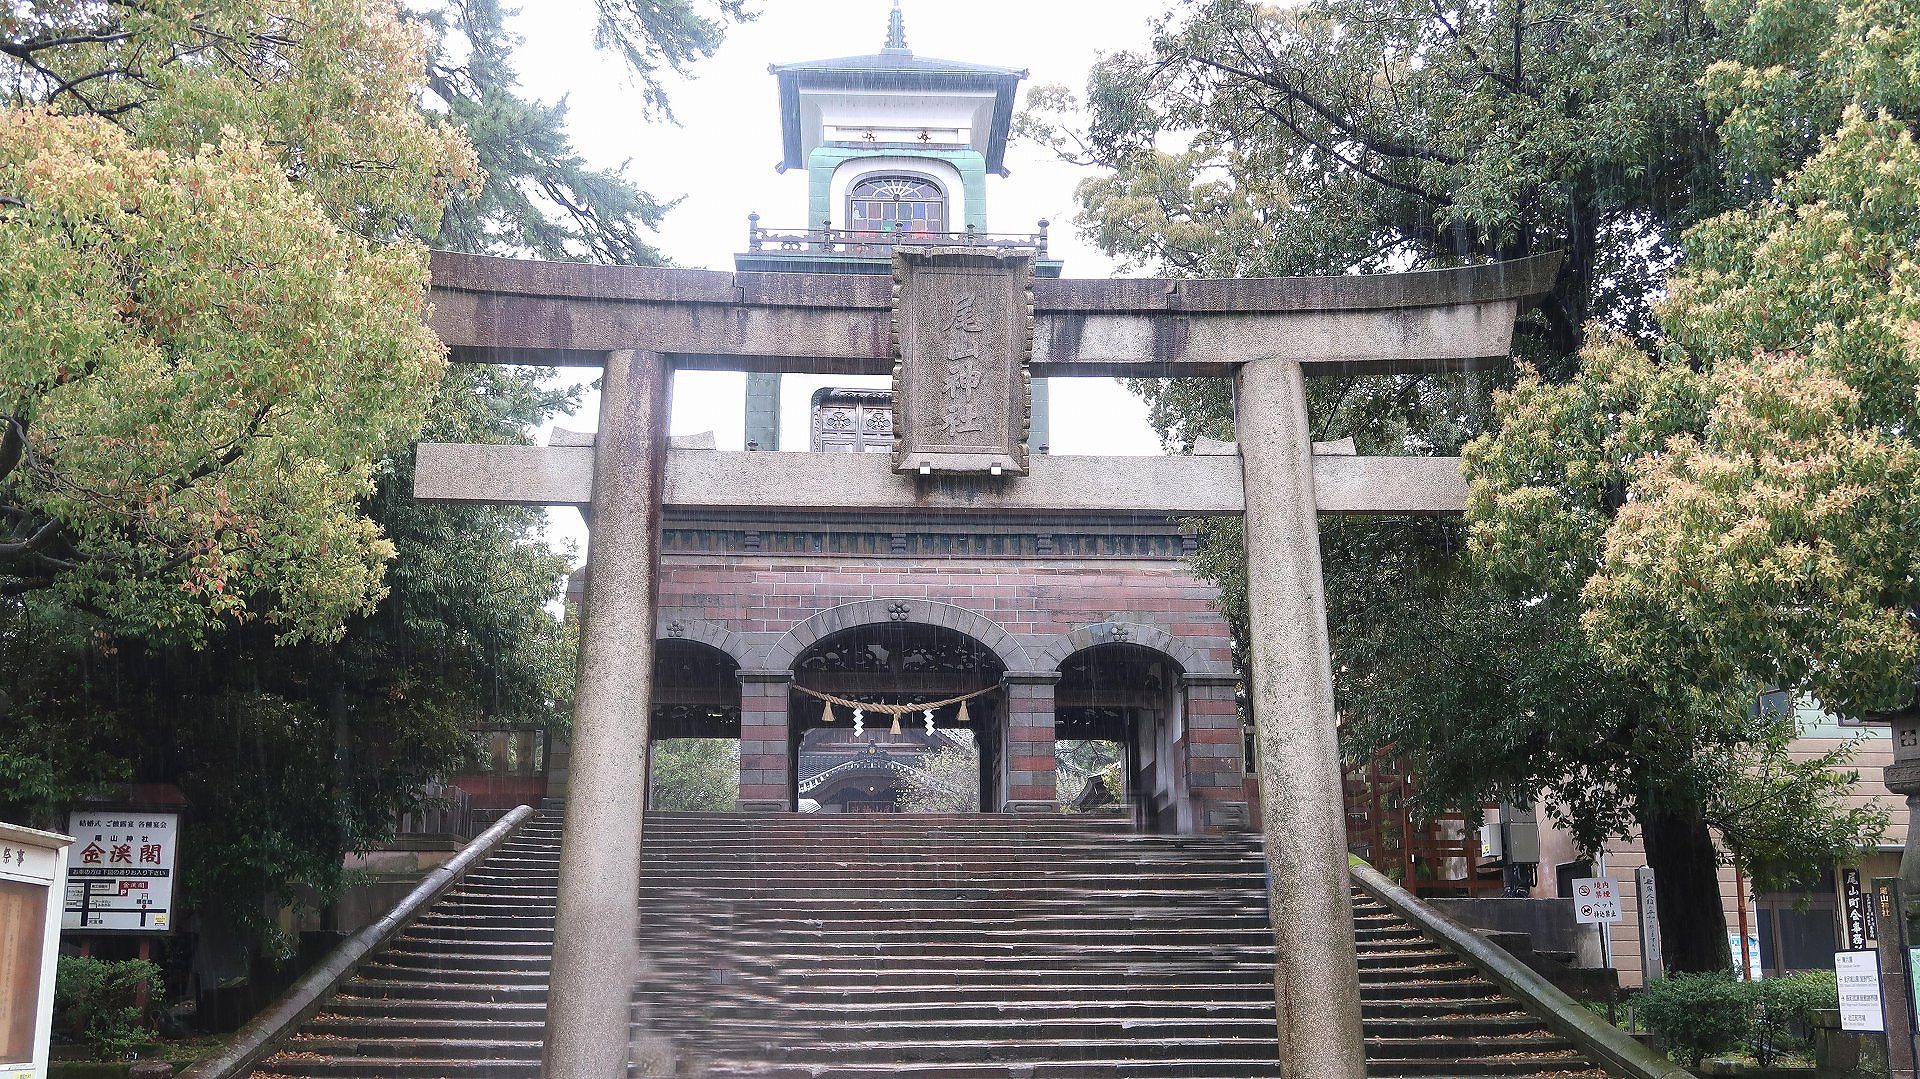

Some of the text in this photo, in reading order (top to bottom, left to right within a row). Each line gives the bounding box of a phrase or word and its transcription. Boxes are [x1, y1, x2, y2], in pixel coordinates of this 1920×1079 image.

[940, 295, 983, 437] 尾山神社
[138, 821, 167, 829] 各種宴会
[1593, 881, 1609, 889] 境内
[1595, 890, 1611, 898] 禁煙
[1593, 900, 1614, 908] ペット
[1879, 886, 1891, 917] 尾山神社
[1846, 872, 1865, 950] 尾山町会事務
